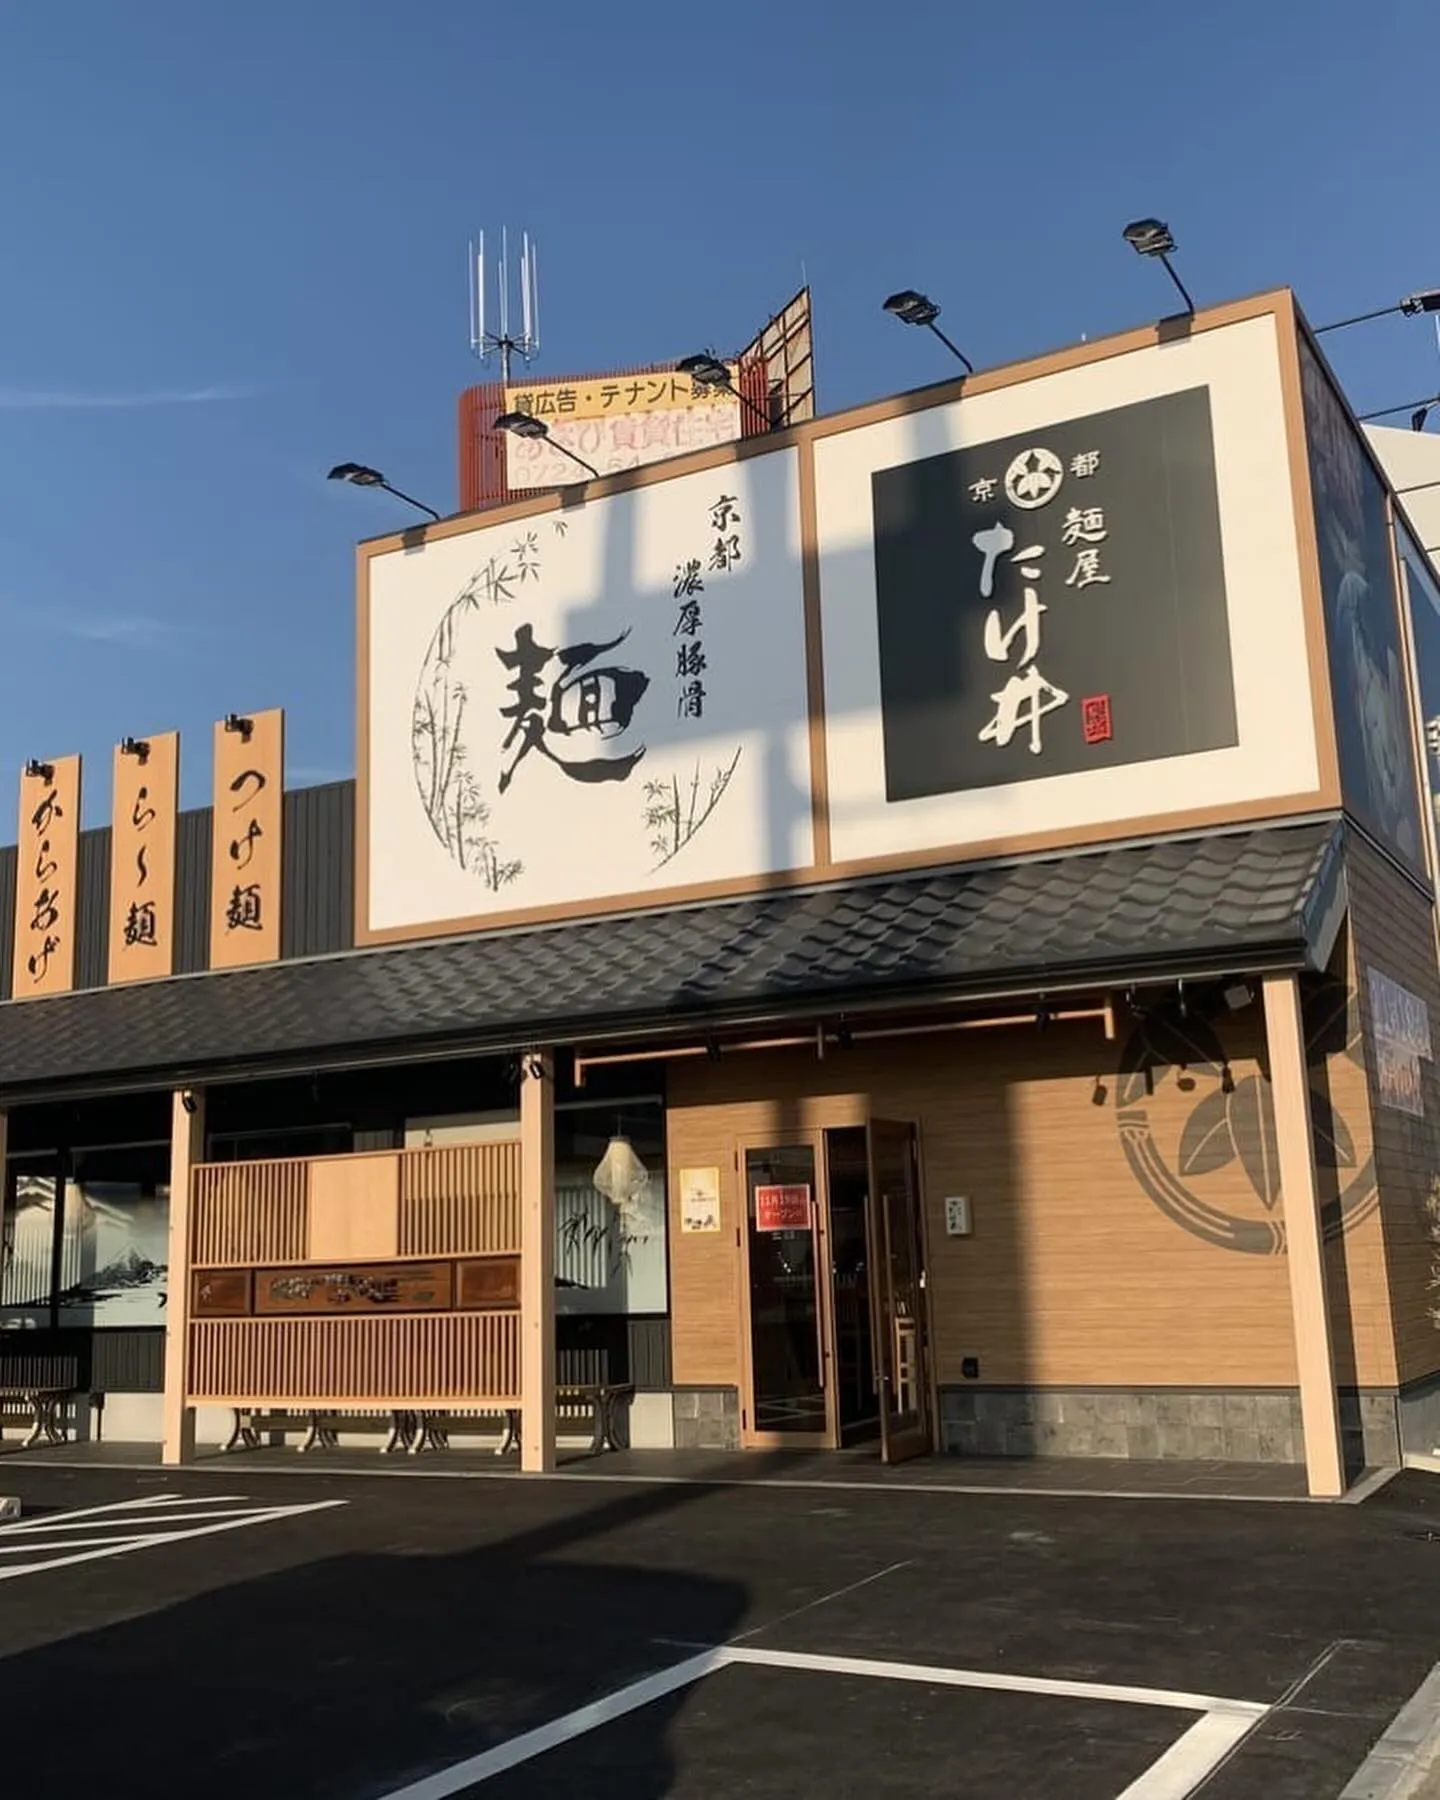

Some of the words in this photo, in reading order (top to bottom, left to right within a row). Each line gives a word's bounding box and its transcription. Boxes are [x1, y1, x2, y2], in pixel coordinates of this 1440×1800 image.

[708, 494, 742, 573] 京都
[1061, 506, 1112, 590] 麺屋
[494, 622, 652, 796] 麺
[672, 558, 708, 720] 濃厚豚骨
[971, 521, 1070, 755] たけ井
[28, 789, 63, 984] からあげ
[225, 770, 267, 936] つけ麺
